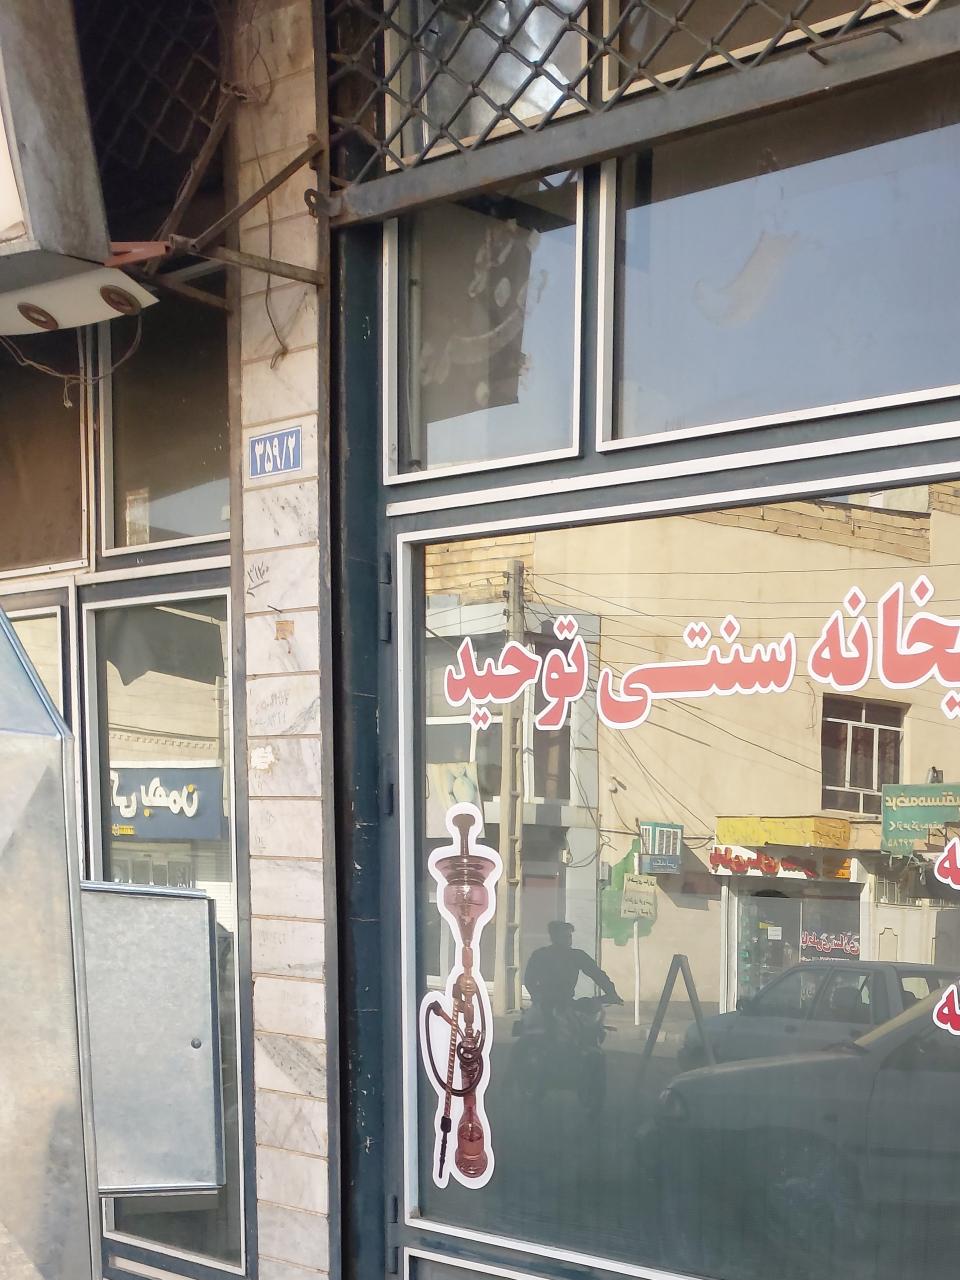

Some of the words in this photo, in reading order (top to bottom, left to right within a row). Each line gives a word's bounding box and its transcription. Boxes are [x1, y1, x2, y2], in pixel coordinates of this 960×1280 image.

[255, 433, 296, 475] ۳۵۹/۲
[444, 614, 588, 731] توحید
[598, 614, 796, 730] سنتی
